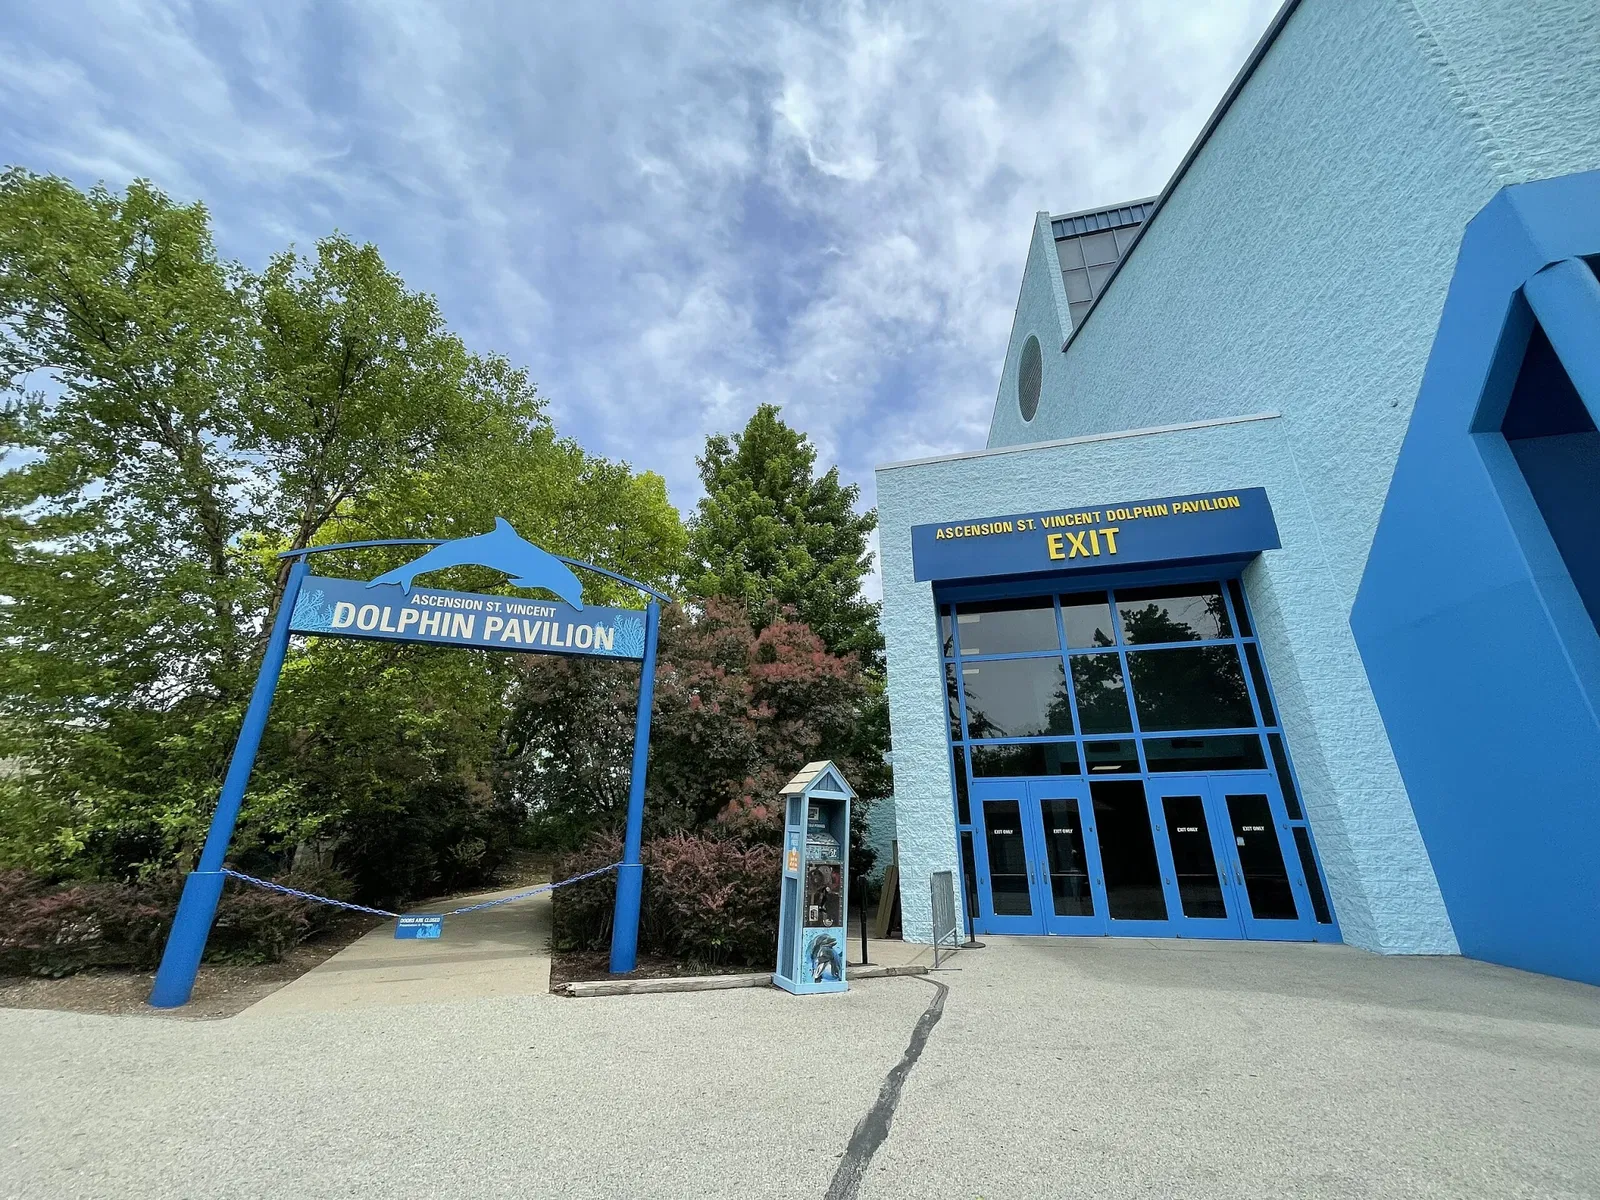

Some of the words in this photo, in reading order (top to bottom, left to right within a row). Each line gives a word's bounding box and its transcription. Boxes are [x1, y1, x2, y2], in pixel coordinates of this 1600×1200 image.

[935, 521, 1013, 540] ASCENSION
[1017, 518, 1037, 532] ST.
[1040, 511, 1101, 529] VINCENT
[1106, 504, 1169, 522] DOLPHIN
[1172, 496, 1240, 515] PAVILION
[1047, 527, 1120, 561] EXIT
[411, 594, 483, 611] ASCENSION
[486, 601, 502, 613] ST.
[506, 603, 556, 618] VINCENT
[332, 601, 476, 639] DOLPHIN
[483, 616, 615, 651] PAVILION
